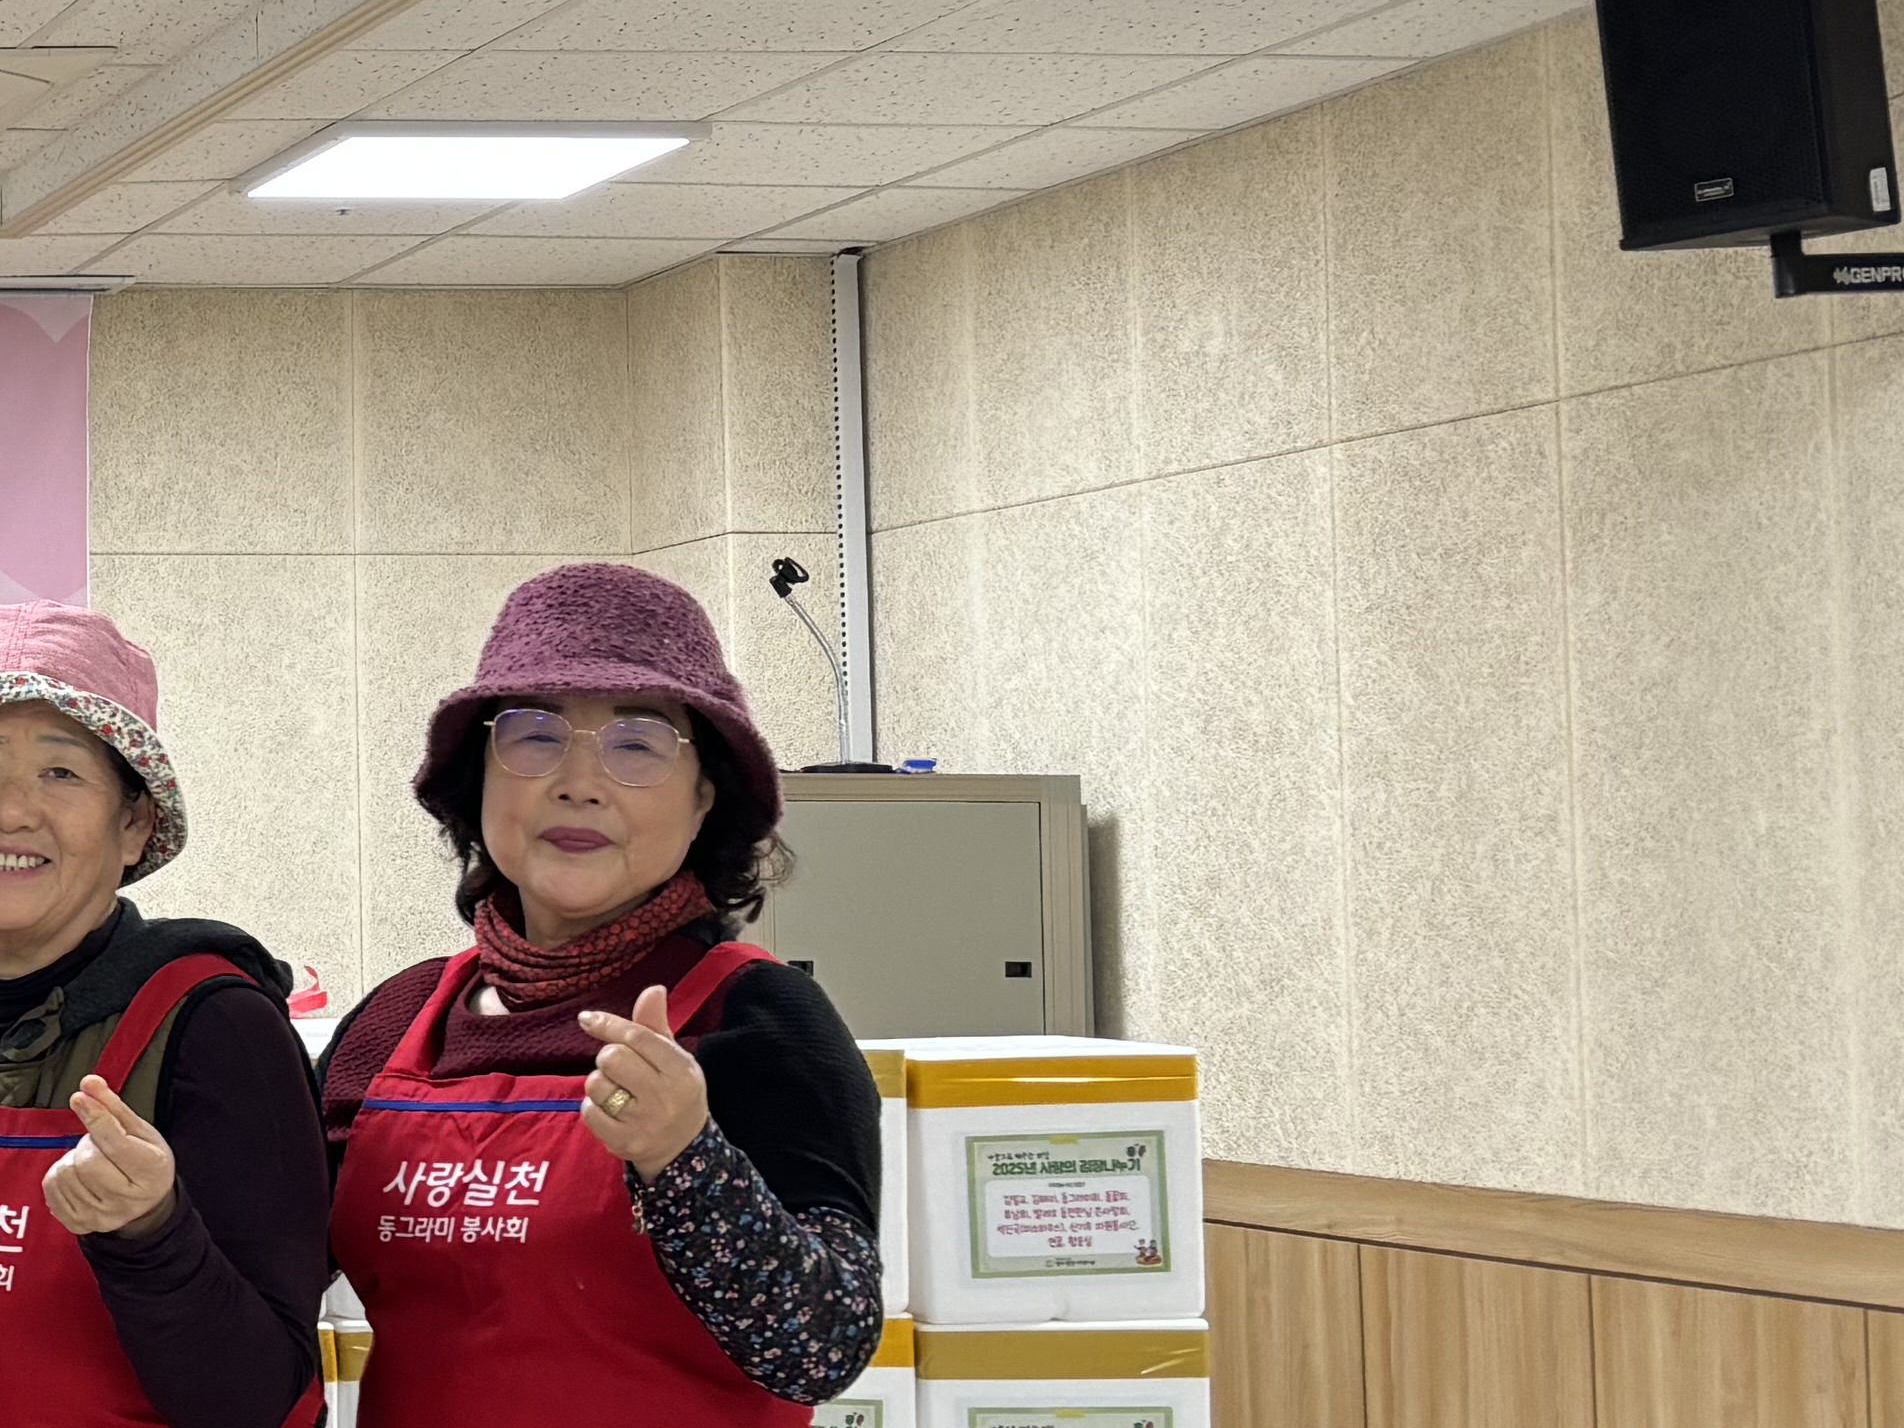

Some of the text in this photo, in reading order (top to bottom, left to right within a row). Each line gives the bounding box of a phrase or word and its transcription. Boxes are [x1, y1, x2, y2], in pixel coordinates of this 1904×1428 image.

[1849, 266, 1904, 285] GENPR
[991, 1161, 1036, 1176] 2025년
[382, 1159, 550, 1207] 사랑실천
[376, 1215, 530, 1245] 동그라미 봉사회
